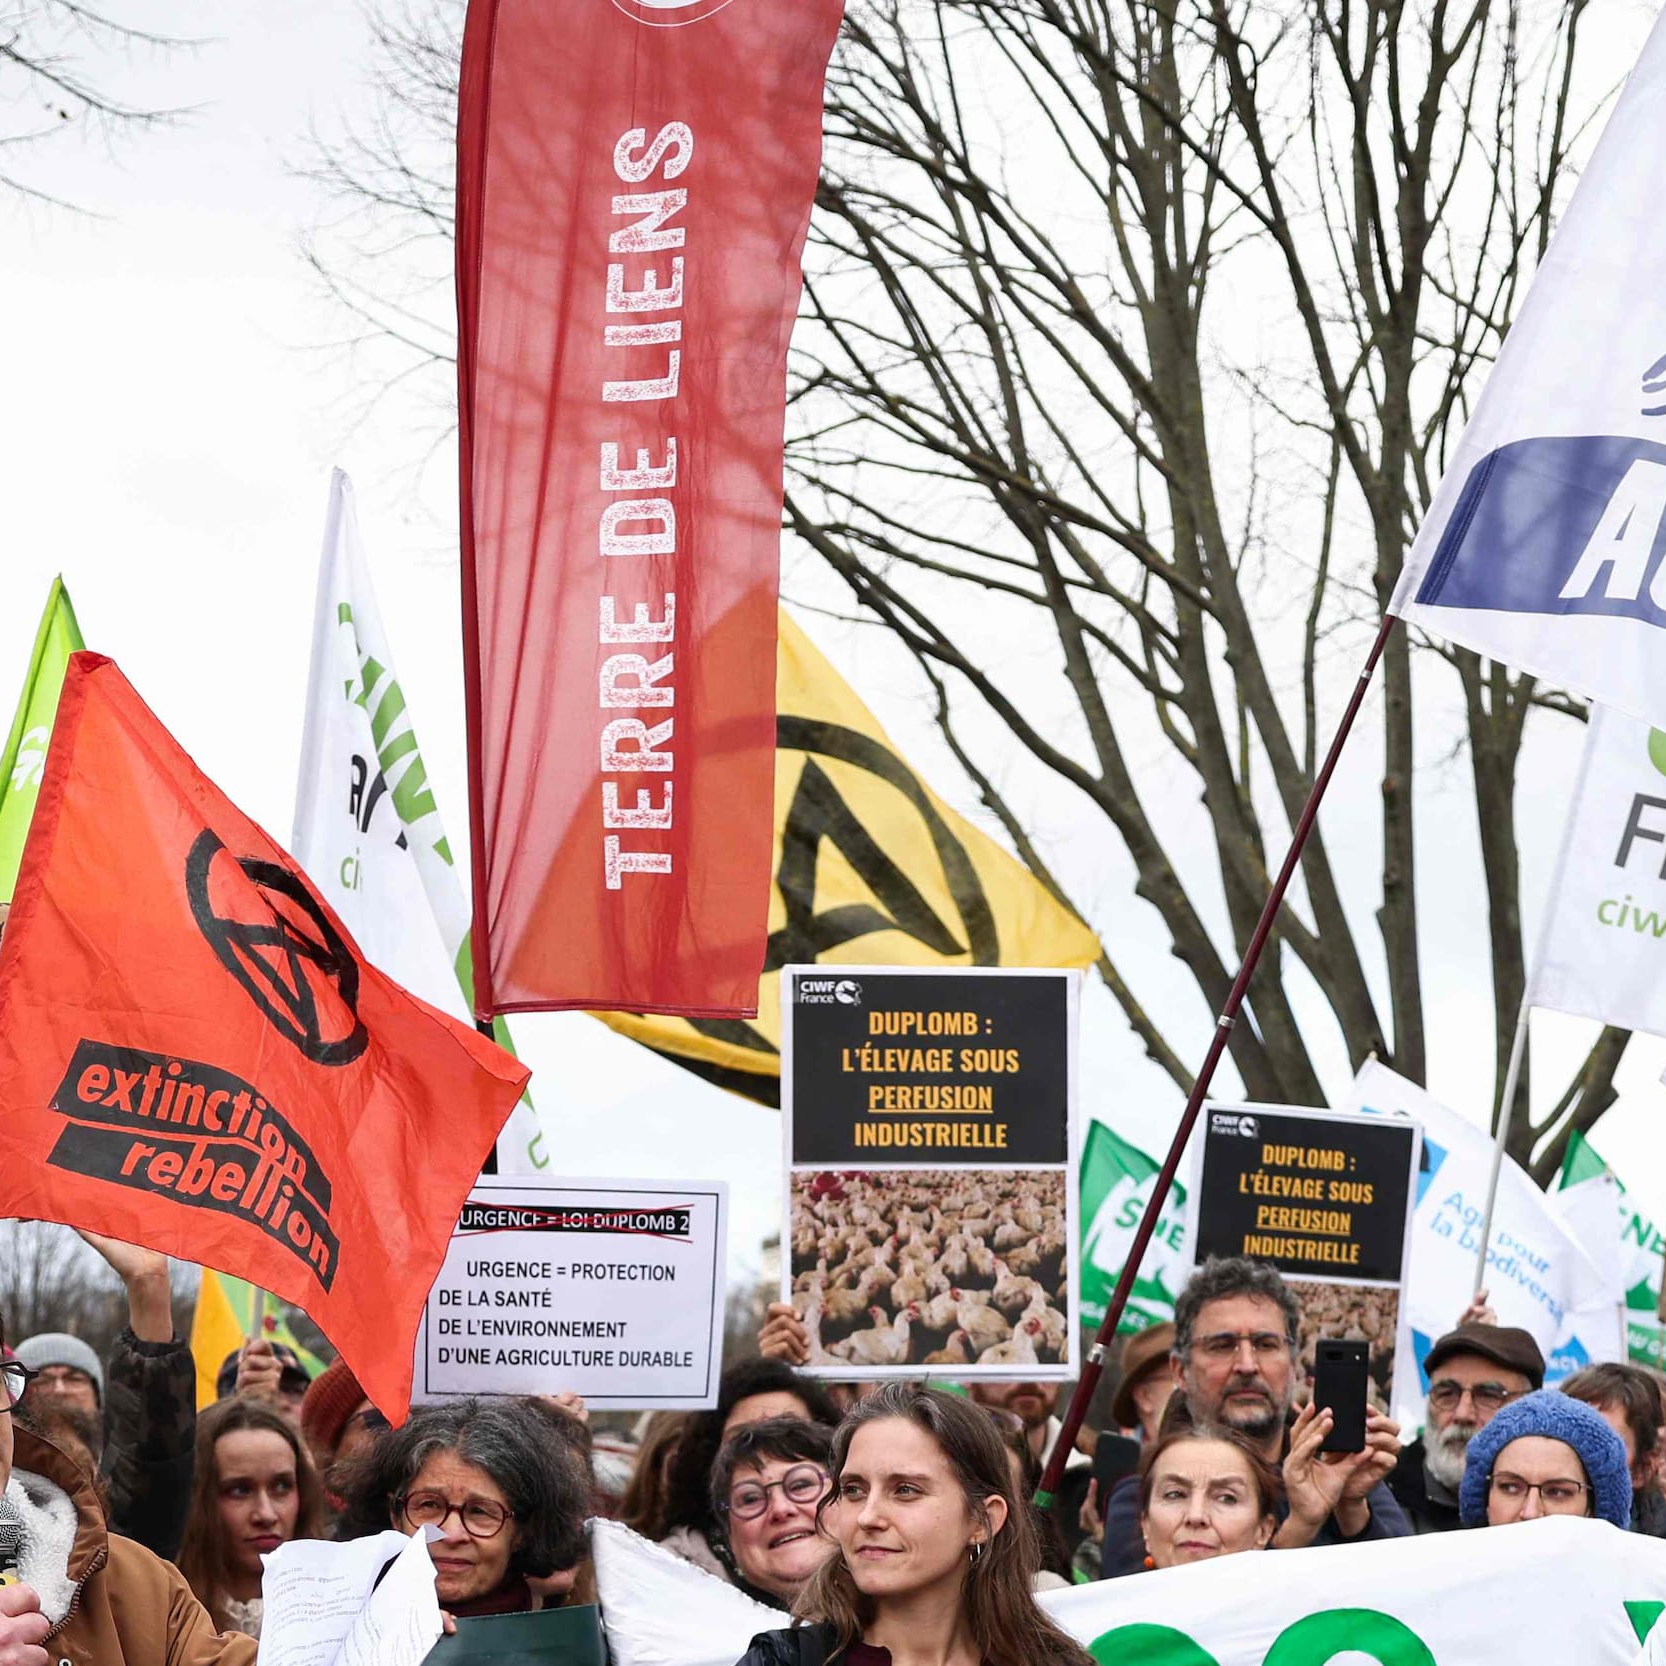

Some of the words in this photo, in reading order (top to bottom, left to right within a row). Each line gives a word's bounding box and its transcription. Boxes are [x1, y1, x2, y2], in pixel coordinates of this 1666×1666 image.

[601, 120, 695, 403] LIENS
[599, 436, 677, 557] DE
[599, 591, 676, 891] TERRE
[800, 980, 836, 994] CIWF
[800, 992, 835, 1005] France
[869, 1011, 979, 1036] DUPLOMB
[842, 1041, 954, 1073] L'ÉLEVAGE
[960, 1048, 1021, 1074] SOUS
[868, 1085, 994, 1111] PERFUSION
[75, 1061, 308, 1187] extinction
[854, 1122, 1008, 1149] INDUSTRIELLE
[1262, 1143, 1346, 1172] DUPLOMB
[1239, 1168, 1326, 1200] L'ÉLEVAGE
[1329, 1181, 1375, 1205] SOUS
[119, 1140, 332, 1277] rebellion
[460, 1210, 541, 1228] URGENCE
[593, 1213, 676, 1232] DUPLOMB
[679, 1215, 690, 1232] 2
[1257, 1204, 1352, 1235] PERFUSION
[1430, 1211, 1453, 1238] la
[1243, 1233, 1361, 1266] INDUSTRIELLE
[1498, 1232, 1551, 1274] pour
[467, 1260, 552, 1279] URGENCE
[571, 1263, 676, 1282] PROTECTION
[439, 1289, 462, 1306] DE
[468, 1290, 490, 1307] LA
[495, 1287, 552, 1308] SANTÉ
[439, 1319, 462, 1335] DE
[467, 1319, 627, 1338] L'ENVIRONNEMENT
[438, 1347, 491, 1365] D'UNE
[495, 1348, 614, 1367] AGRICULTURE
[618, 1350, 693, 1368] DURABLE
